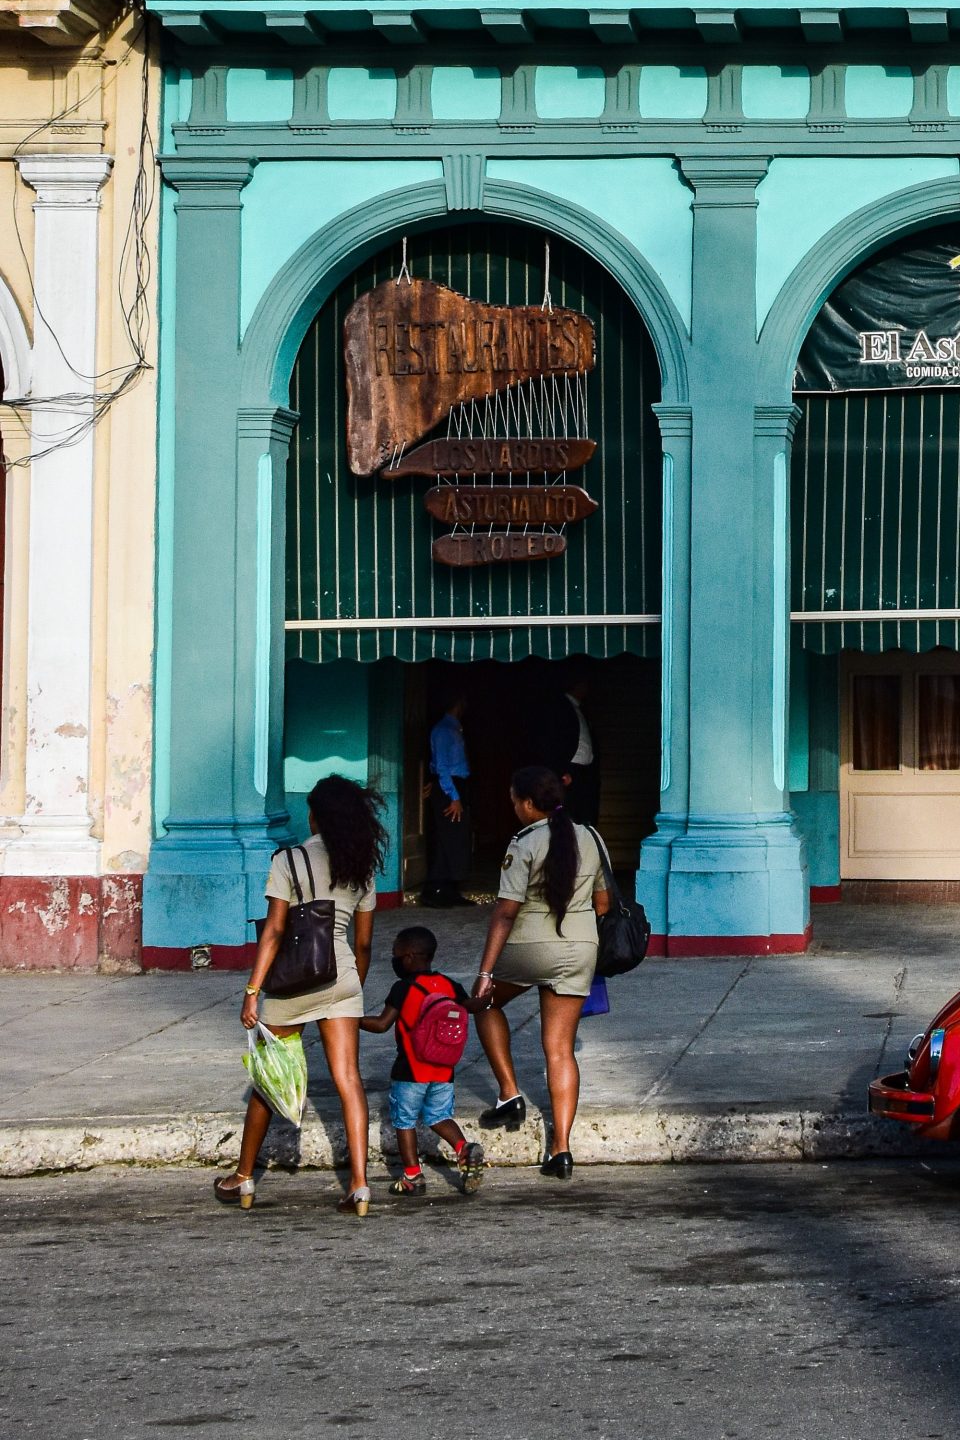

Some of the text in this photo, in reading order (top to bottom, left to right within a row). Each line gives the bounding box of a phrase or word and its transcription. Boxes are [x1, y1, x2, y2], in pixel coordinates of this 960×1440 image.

[861, 330, 900, 363] El
[905, 365, 949, 378] COMIDA
[432, 440, 569, 471] LOS NARDOS
[444, 492, 577, 523] ASTURIANITO
[452, 535, 557, 566] TROFEO
